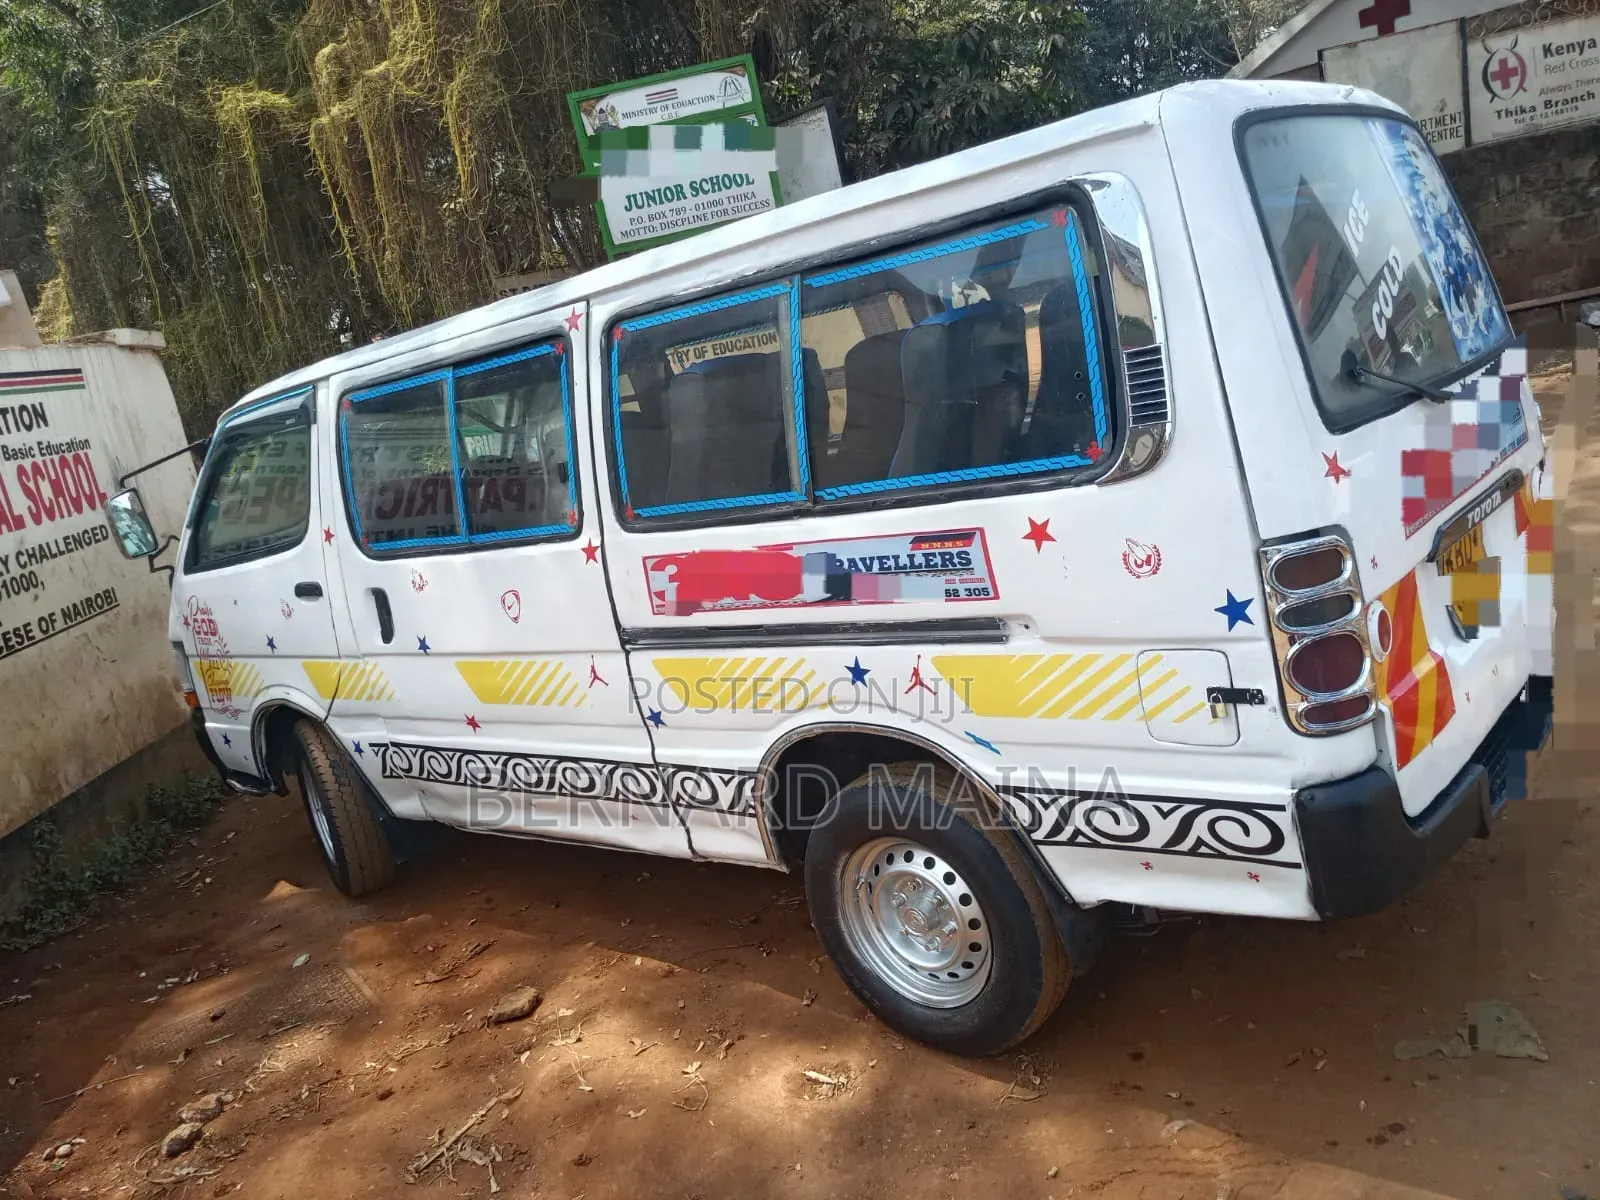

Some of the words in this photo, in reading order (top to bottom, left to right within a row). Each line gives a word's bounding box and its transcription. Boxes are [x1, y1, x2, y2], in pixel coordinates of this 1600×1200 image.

[1542, 38, 1597, 60] Kenya
[1544, 60, 1566, 75] Red
[1569, 56, 1600, 70] Cross
[621, 106, 658, 121] MINISTRY
[660, 103, 671, 112] OF
[672, 94, 716, 110] EDUACTION
[1495, 104, 1537, 120] Thika
[1543, 90, 1596, 110] Branch
[1417, 111, 1463, 130] RTMENT
[624, 183, 688, 212] JUNIOR
[688, 173, 755, 198] SCHOOL
[620, 224, 659, 240] MOTTO:
[711, 207, 731, 220] FOR
[731, 198, 771, 216] SUCCESS
[629, 214, 646, 227] P.O.
[647, 210, 668, 222] BOX
[669, 205, 687, 218] 789
[694, 197, 724, 212] 01000
[725, 190, 757, 205] THIKA
[693, 345, 708, 360] OF
[712, 332, 778, 356] EDUCATION
[0, 402, 49, 436] TION
[1, 442, 36, 462] Basic
[37, 436, 92, 458] Education
[16, 451, 109, 527] SCHOOL
[1467, 490, 1502, 529] TOYOTA
[0, 554, 11, 577] Y
[15, 524, 110, 570] CHALLENGED
[0, 570, 45, 601] 1000,
[964, 587, 991, 597] 305
[0, 622, 36, 654] ESE
[37, 612, 57, 636] OF
[60, 586, 119, 626] NAIROBI
[192, 618, 219, 637] GOD
